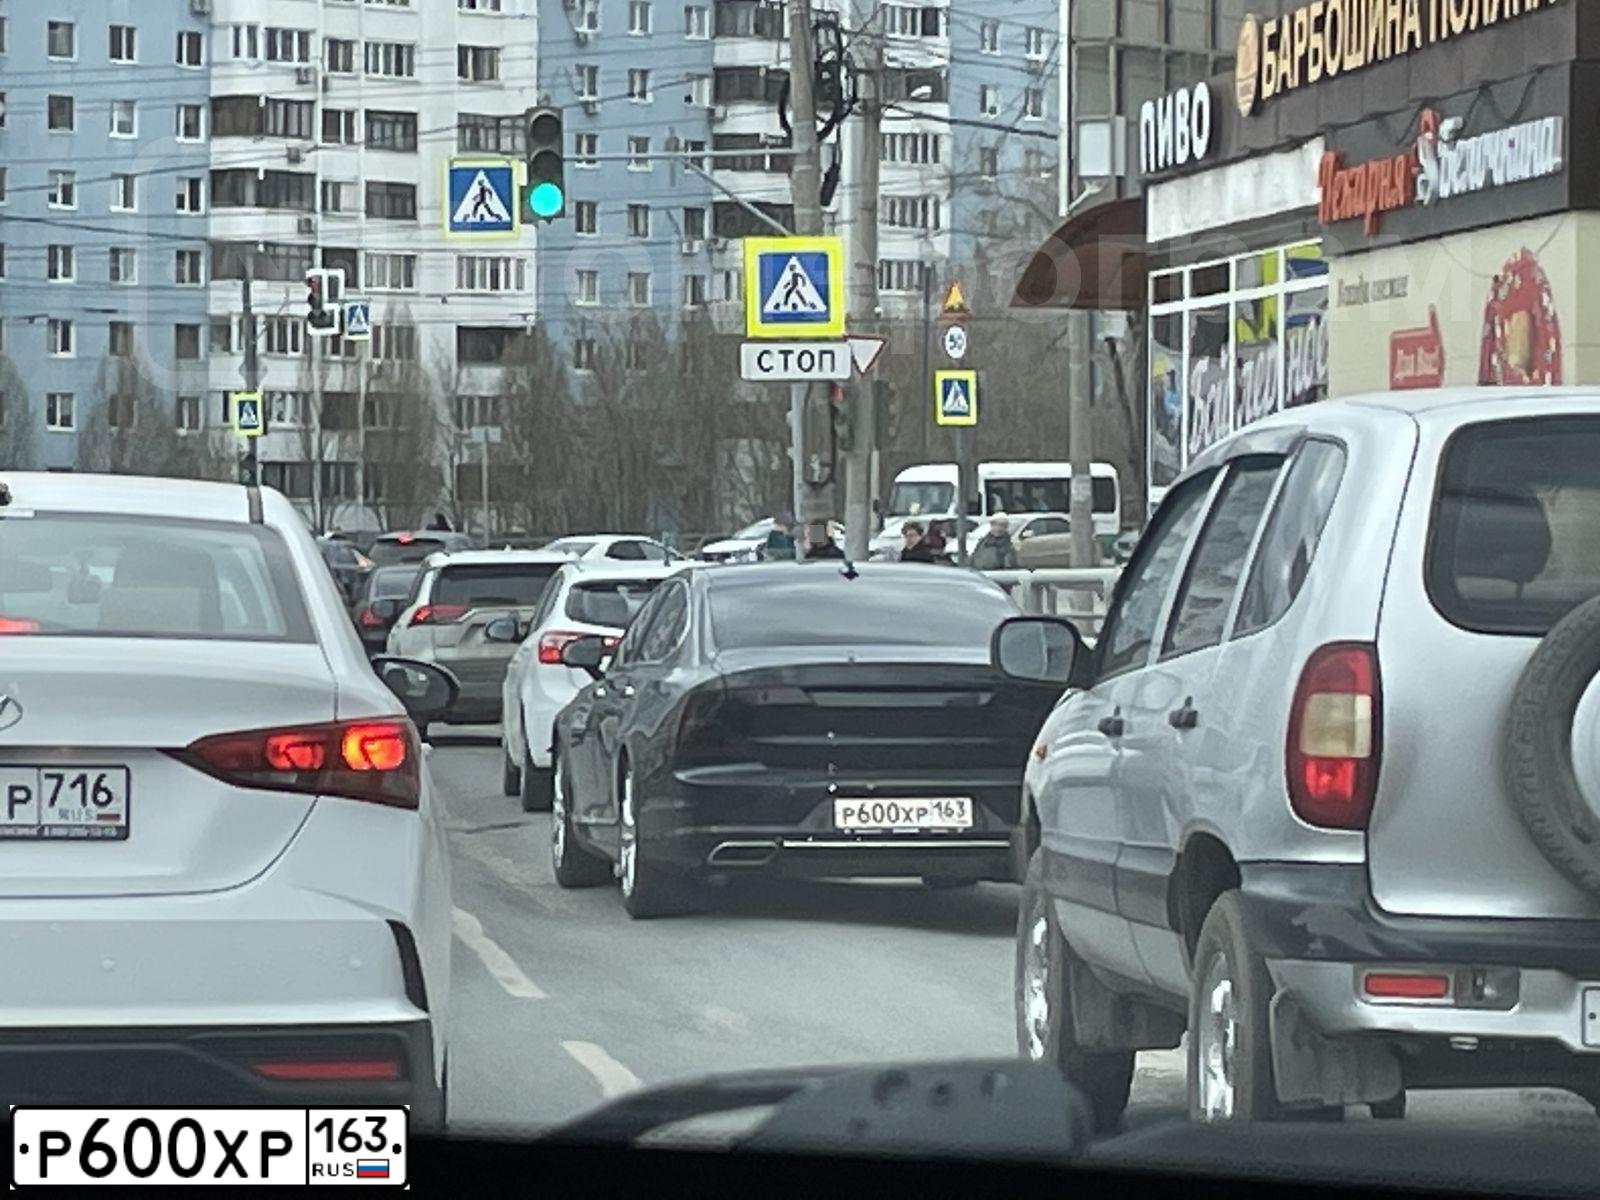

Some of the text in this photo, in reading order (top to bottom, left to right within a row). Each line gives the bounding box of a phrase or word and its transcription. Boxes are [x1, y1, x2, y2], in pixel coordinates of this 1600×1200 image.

[1261, 0, 1421, 100] БАРБОШИНА
[1140, 82, 1210, 174] ПИВО
[757, 350, 836, 373] СТОП
[44, 773, 114, 808] 716
[842, 801, 966, 825] Р600ХР 163
